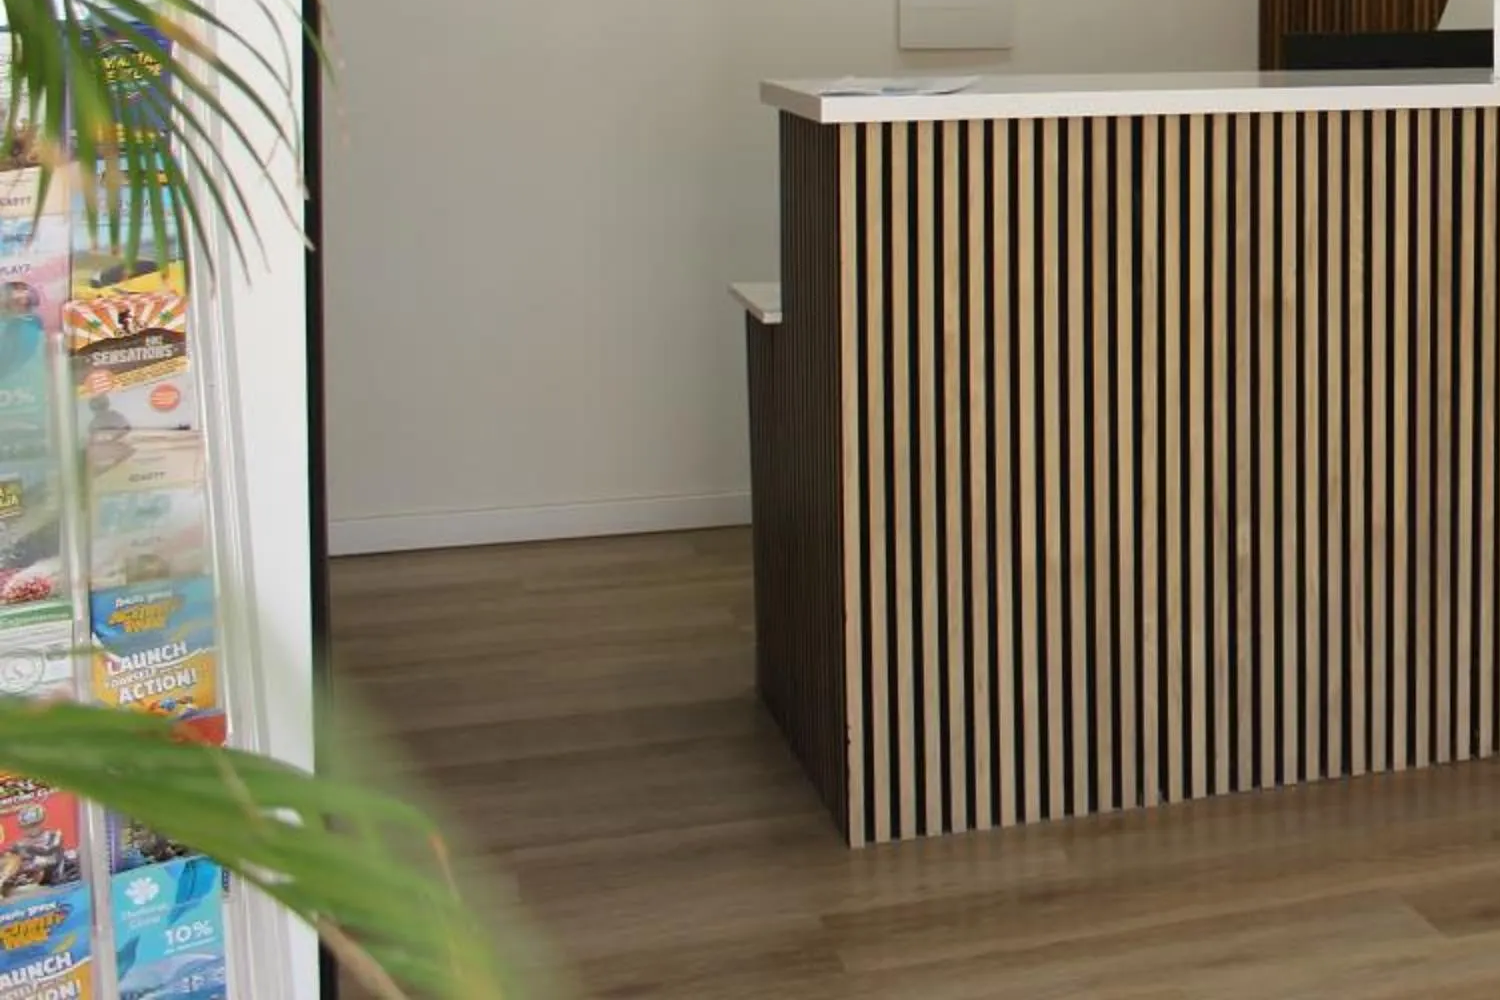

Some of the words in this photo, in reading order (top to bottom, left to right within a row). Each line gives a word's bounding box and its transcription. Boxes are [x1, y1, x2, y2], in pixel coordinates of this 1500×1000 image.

[107, 640, 187, 676] LAUNCH
[119, 667, 198, 704] ACTION!
[164, 920, 214, 946] 10%
[0, 952, 73, 991] AUNCH
